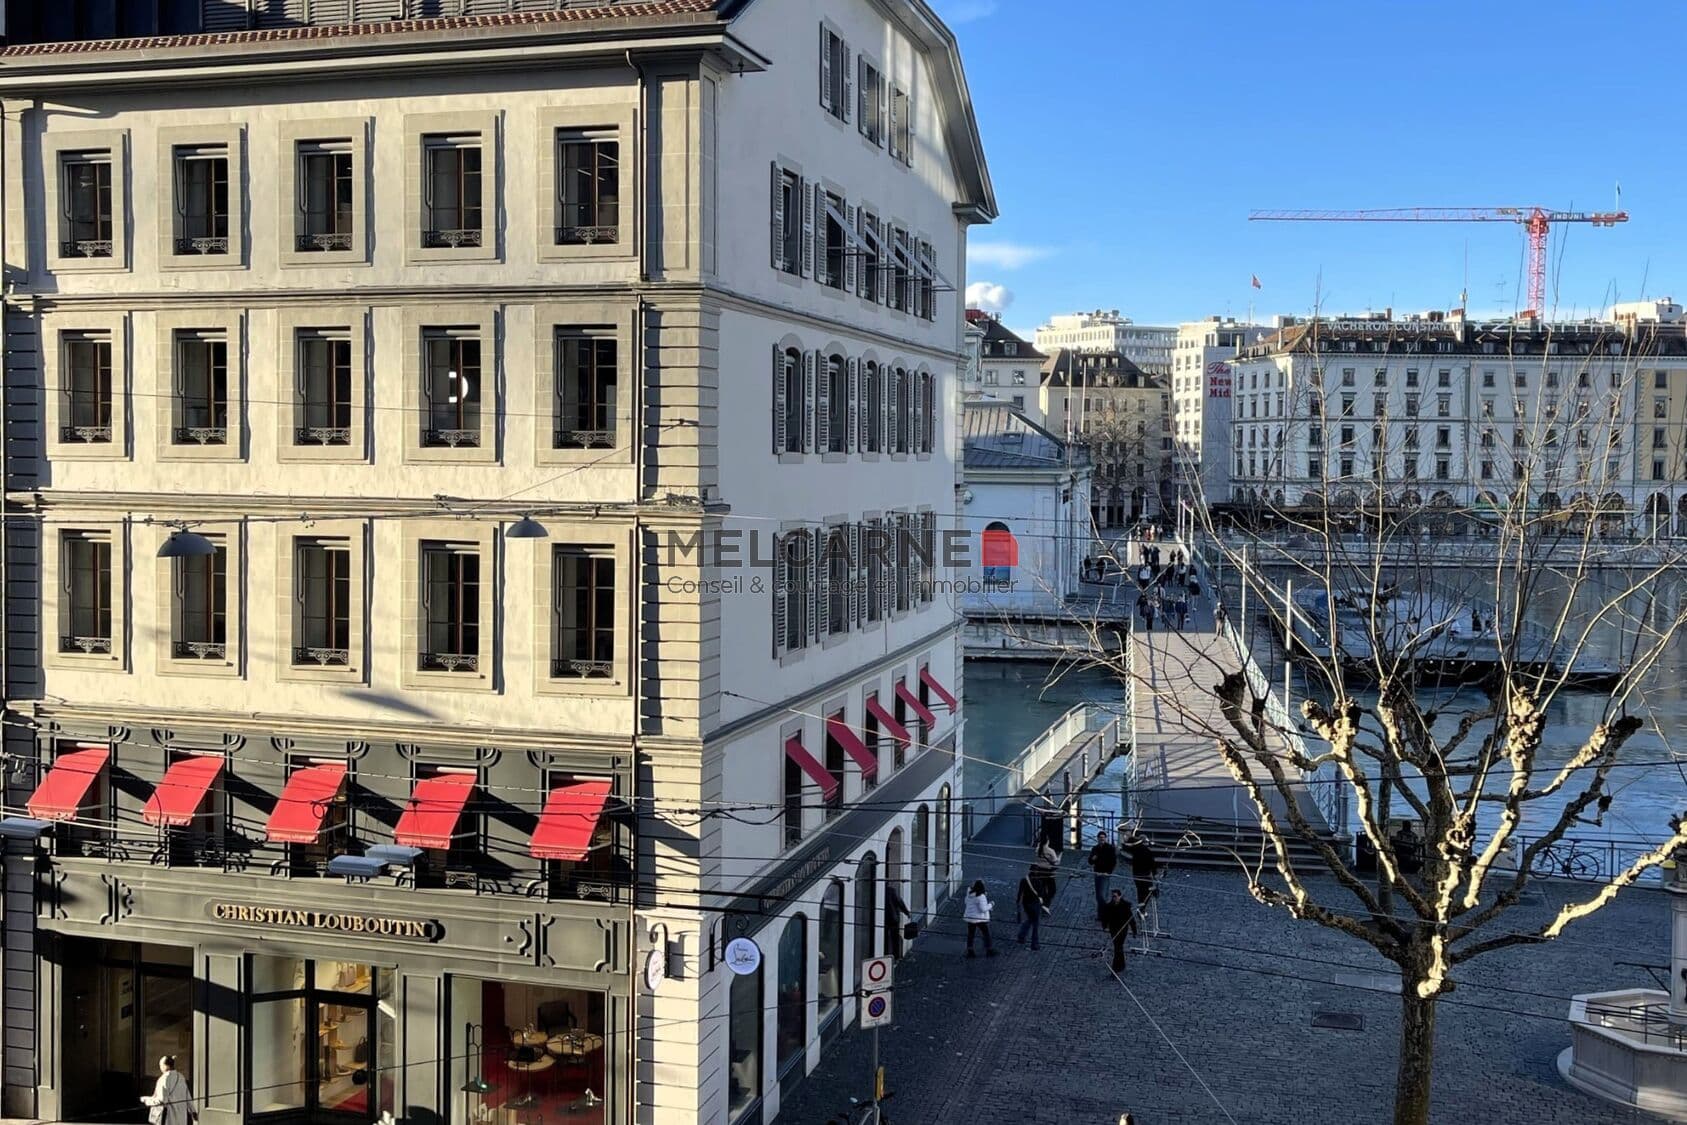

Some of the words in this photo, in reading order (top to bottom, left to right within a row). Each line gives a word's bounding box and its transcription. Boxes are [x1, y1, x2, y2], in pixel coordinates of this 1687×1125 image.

[1327, 321, 1389, 331] VACHERON
[1207, 361, 1231, 374] The
[1210, 376, 1231, 386] New
[1210, 388, 1231, 398] Mid
[213, 903, 308, 926] CHRISTIAN
[314, 912, 426, 937] LOUBOUTIN
